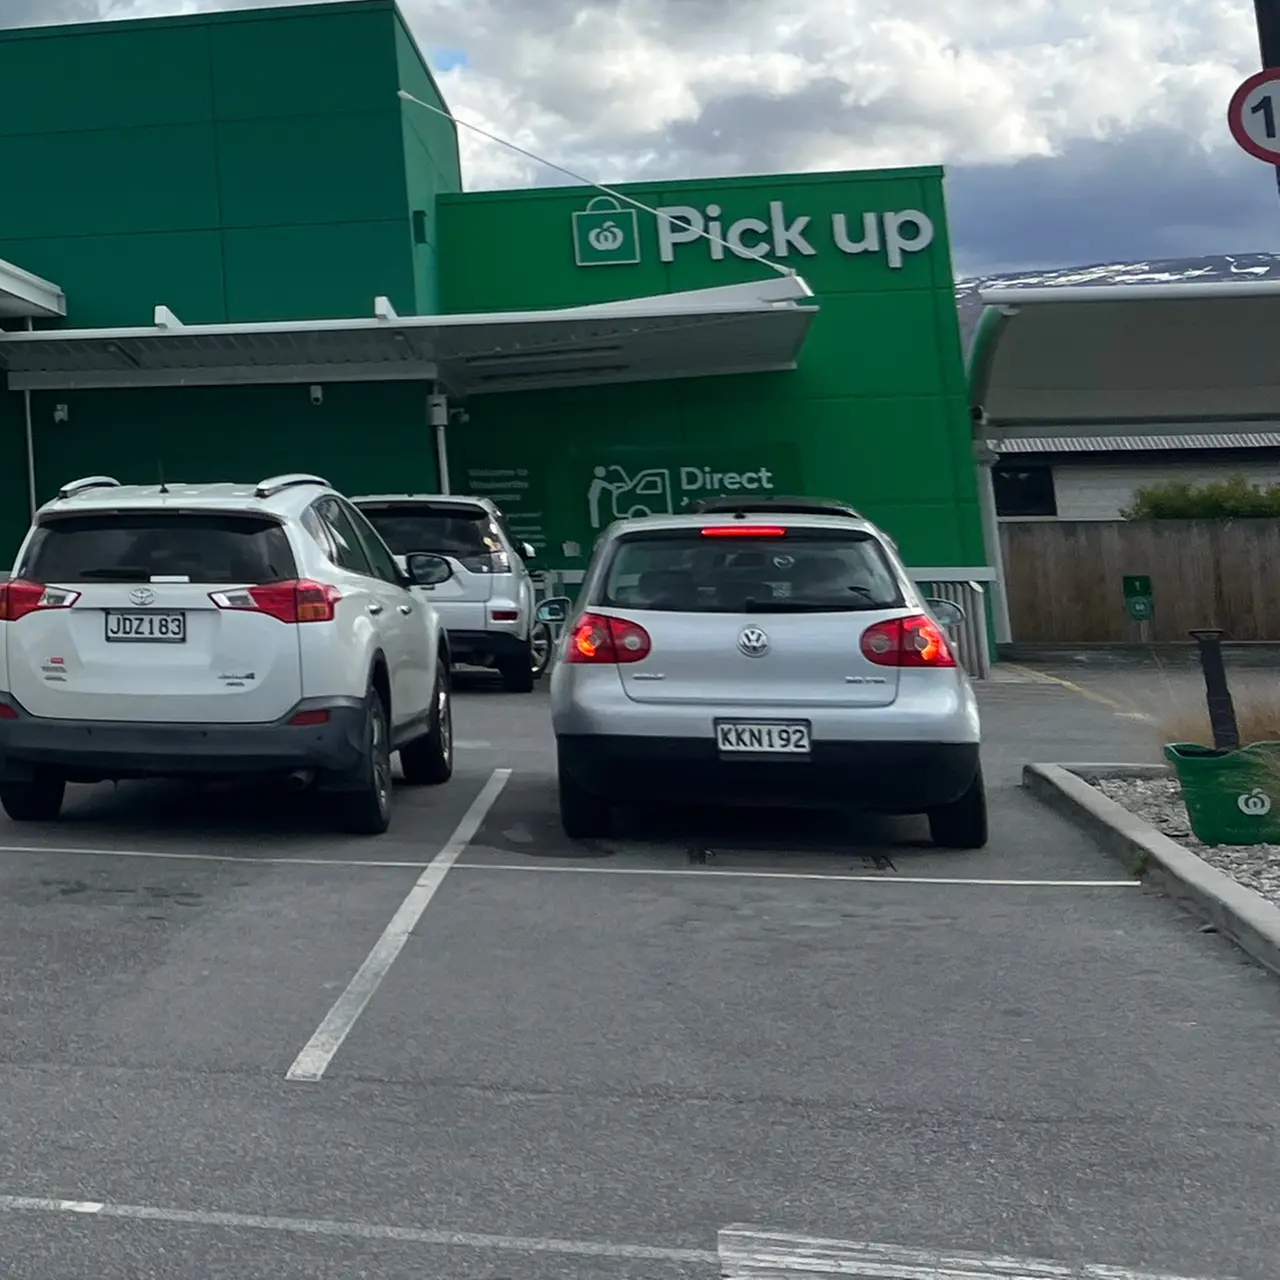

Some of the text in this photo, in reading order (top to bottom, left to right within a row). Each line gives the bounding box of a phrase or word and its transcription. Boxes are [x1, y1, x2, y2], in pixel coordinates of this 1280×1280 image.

[655, 200, 935, 269] Pick up
[679, 466, 775, 491] Direct
[109, 617, 183, 635] JDZ183
[719, 726, 808, 749] KKN192
